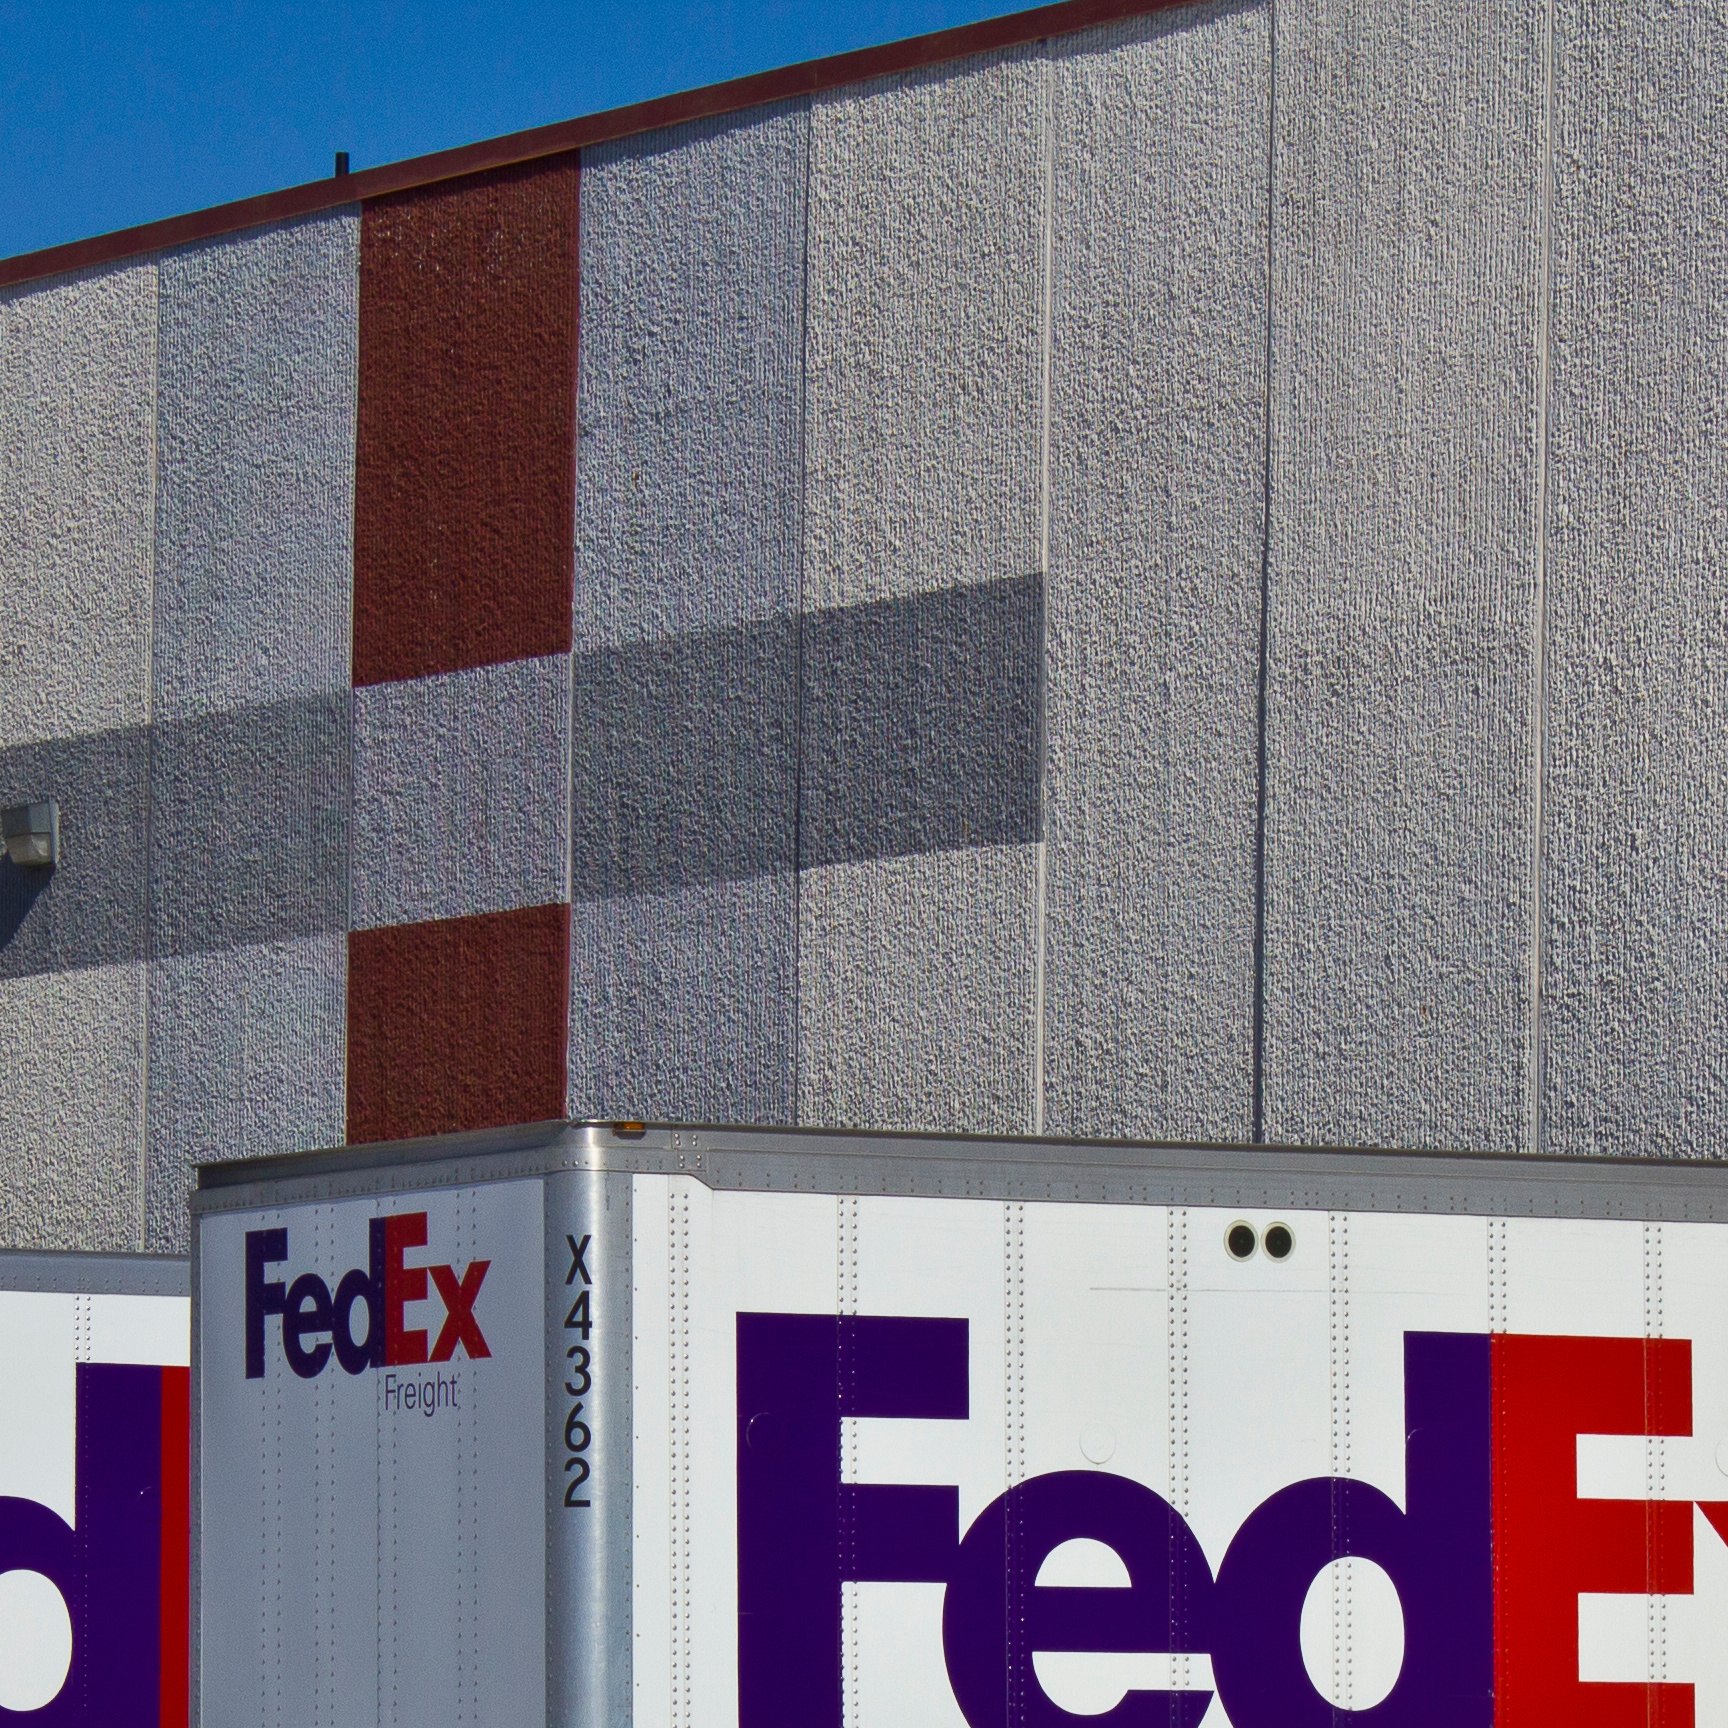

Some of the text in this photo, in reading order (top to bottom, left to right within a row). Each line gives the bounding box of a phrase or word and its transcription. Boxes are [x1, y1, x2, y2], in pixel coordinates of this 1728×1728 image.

[245, 1211, 493, 1379] FedEx
[563, 1234, 593, 1508] X4362
[385, 1371, 459, 1418] Freight
